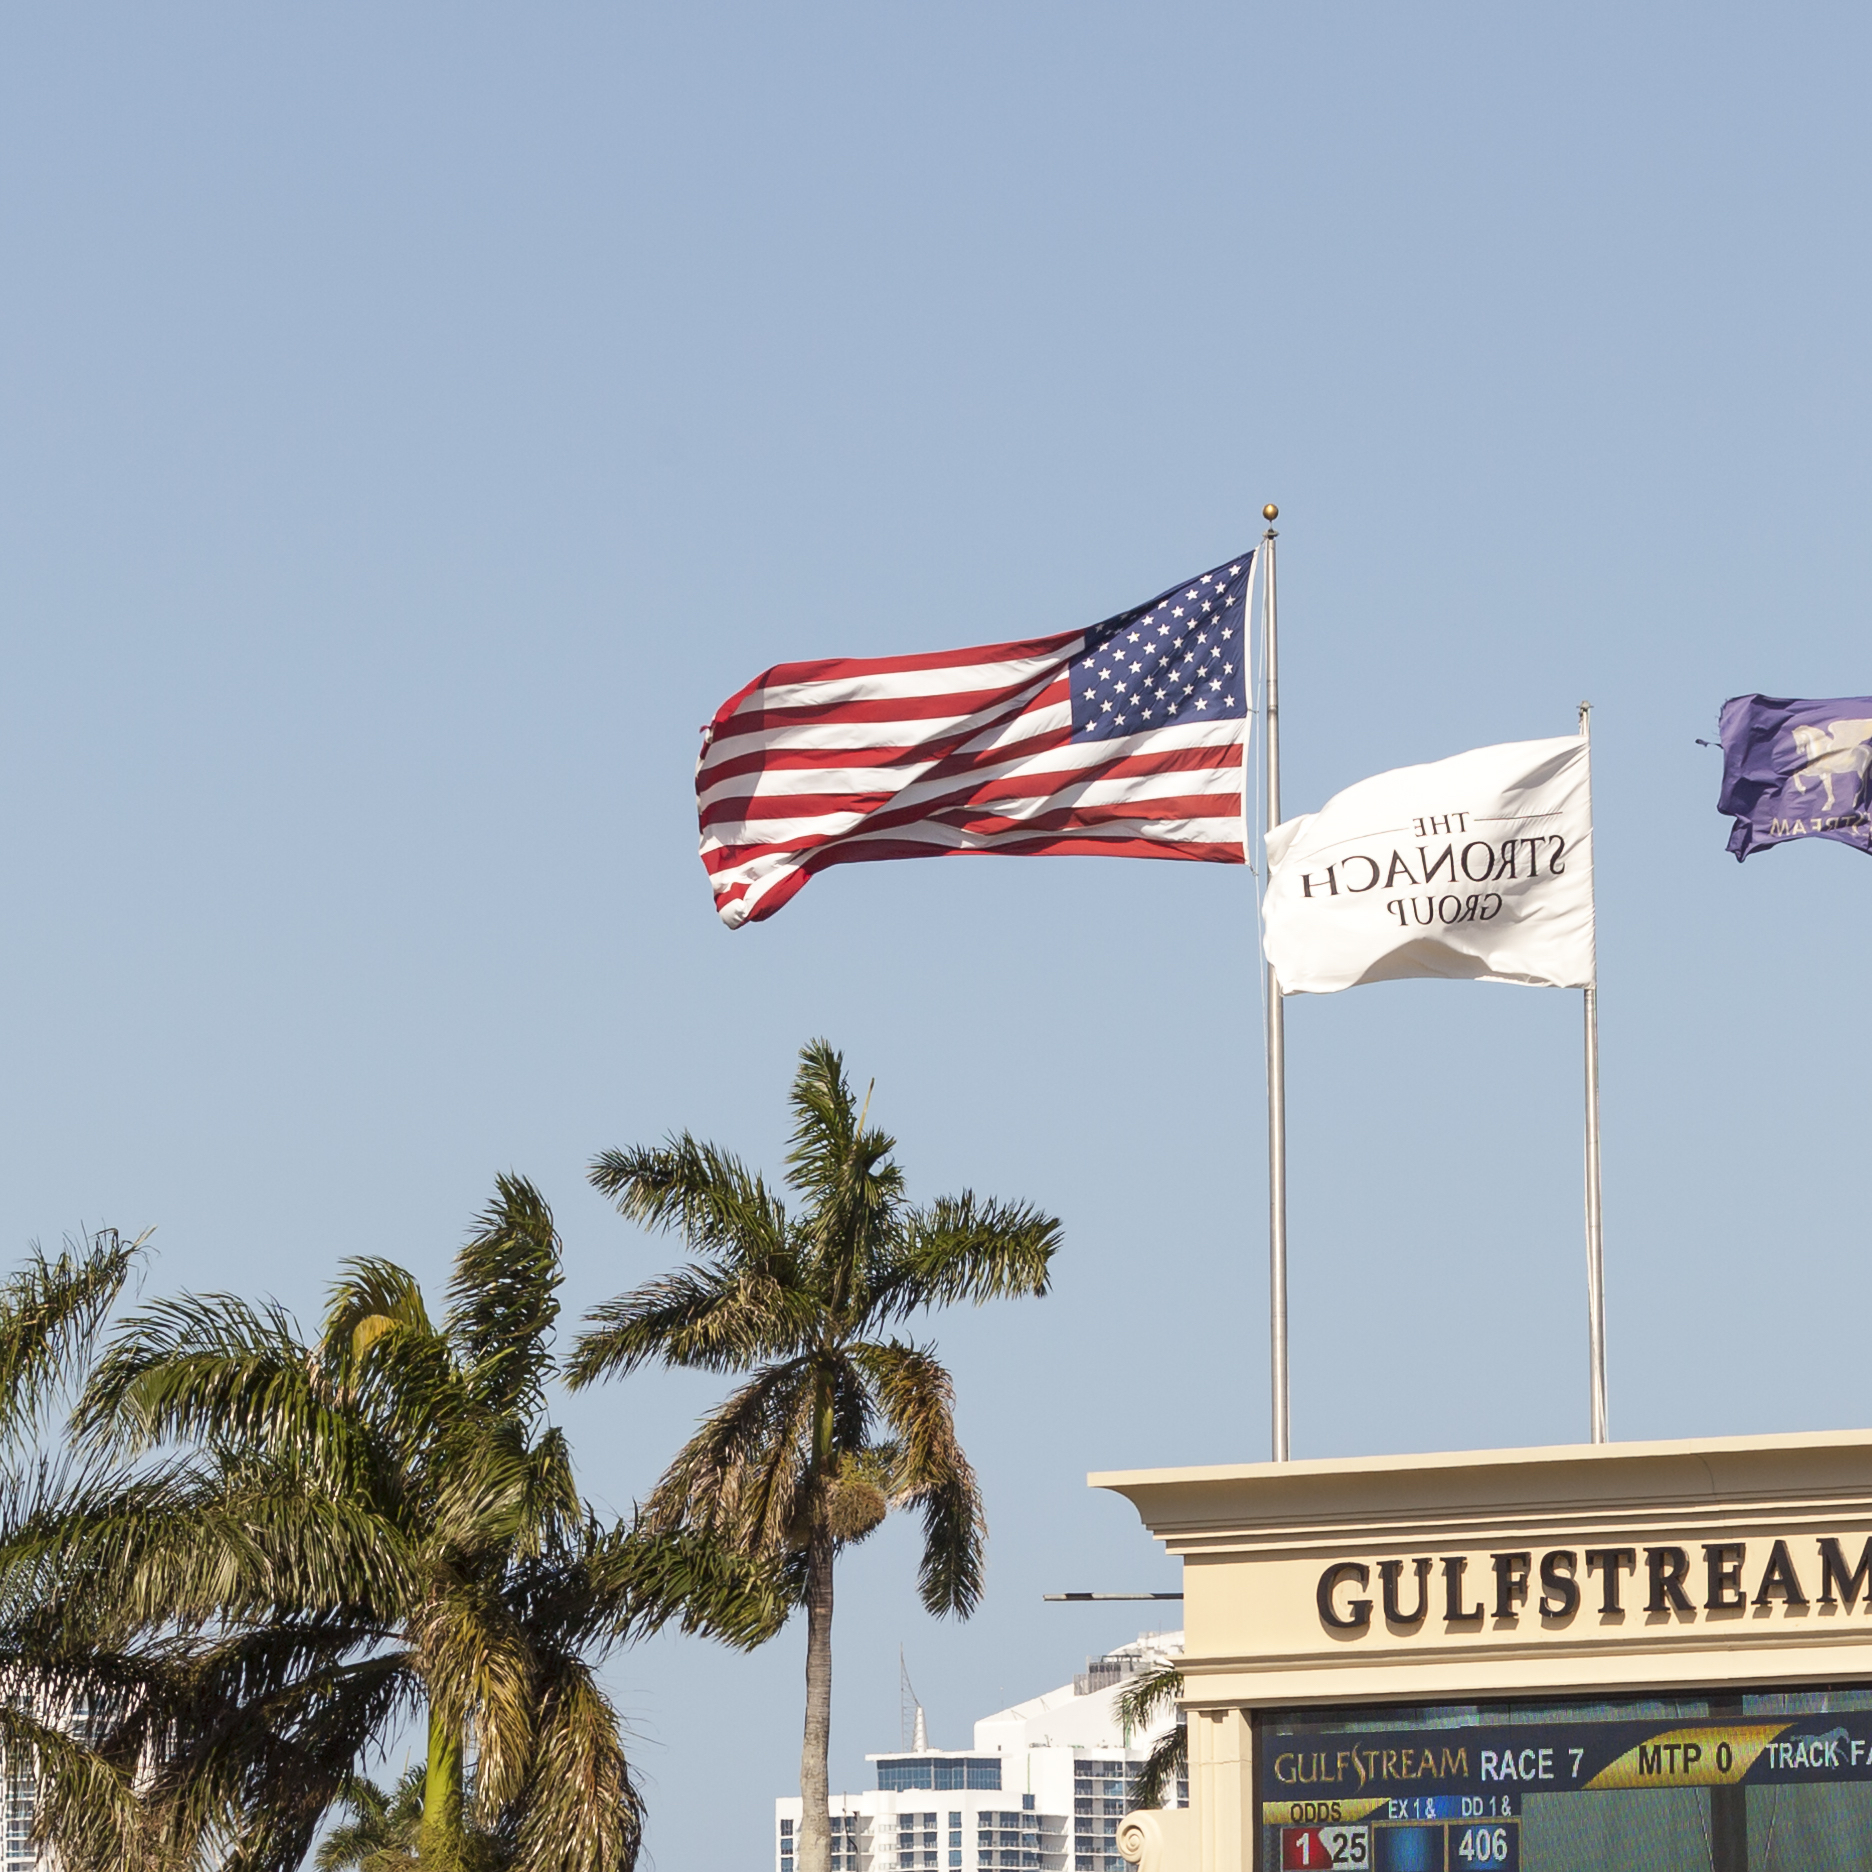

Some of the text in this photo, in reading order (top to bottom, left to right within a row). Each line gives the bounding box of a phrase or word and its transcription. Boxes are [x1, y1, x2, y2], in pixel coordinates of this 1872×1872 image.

[1275, 1741, 1469, 1793] GULFSTREAM
[1481, 1749, 1553, 1781] RACE
[1569, 1748, 1584, 1778] 7
[1639, 1744, 1701, 1775] MTP
[1716, 1742, 1733, 1772] 0
[1765, 1740, 1839, 1769] TRACK
[1290, 1803, 1341, 1823] ODDS
[1389, 1799, 1409, 1819] EX
[1461, 1796, 1484, 1817] DD
[1296, 1829, 1508, 1865] 1 25 406
